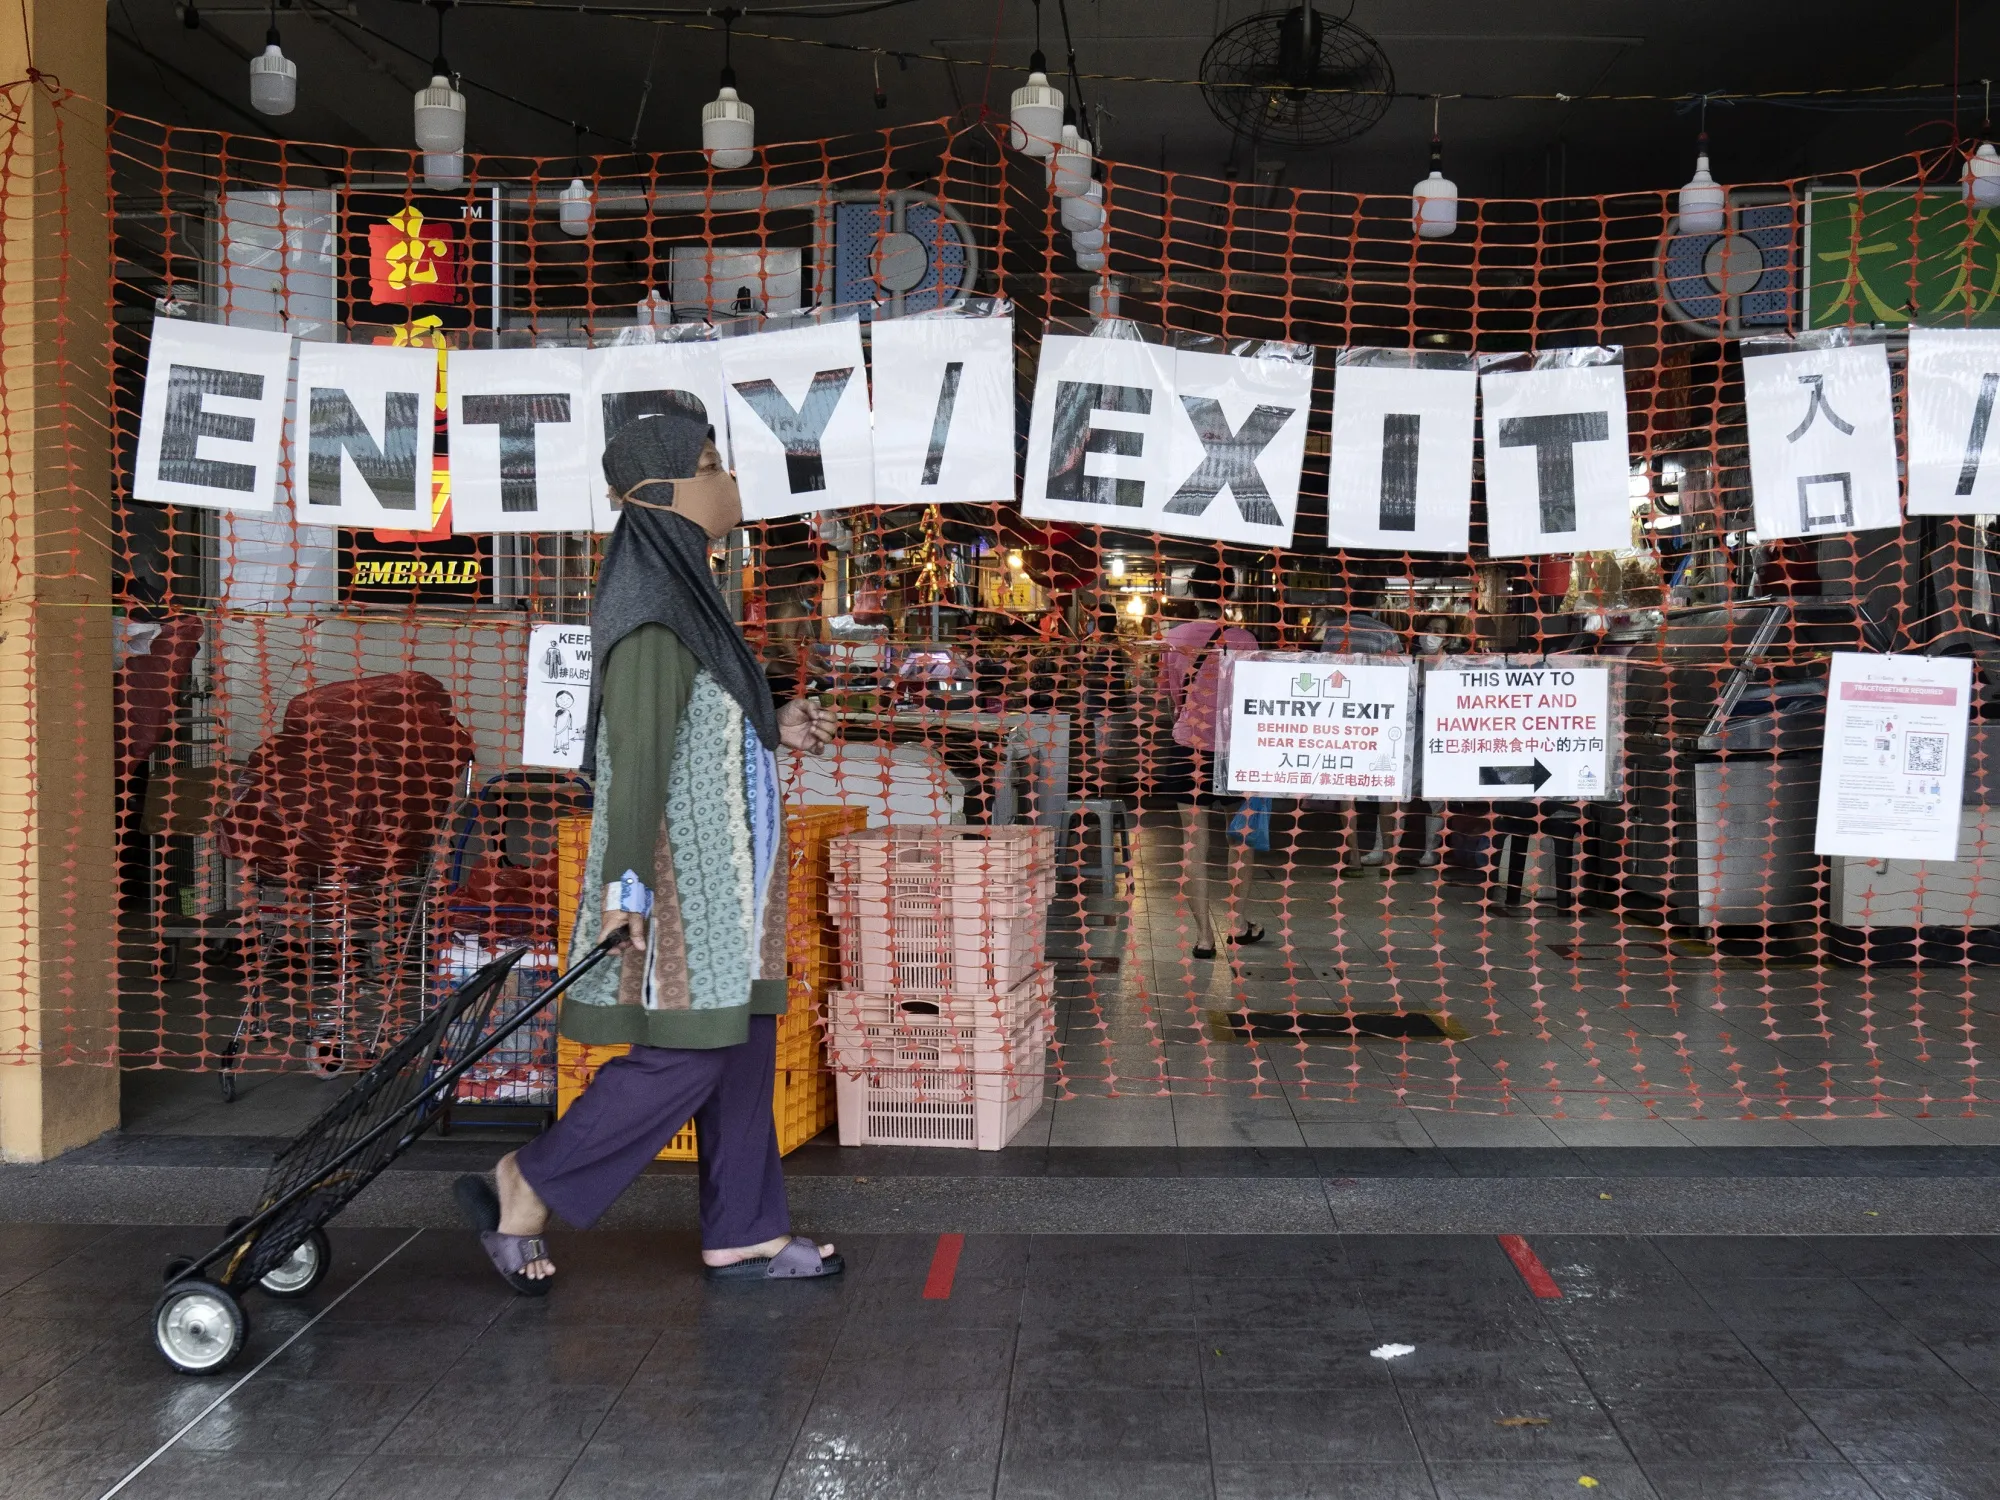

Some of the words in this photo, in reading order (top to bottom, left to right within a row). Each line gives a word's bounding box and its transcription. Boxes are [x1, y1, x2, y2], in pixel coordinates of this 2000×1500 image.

[921, 361, 963, 486] /
[1046, 380, 1609, 534] EXIT
[1786, 374, 1855, 532] 入口
[351, 560, 482, 586] EMERALD
[1460, 672, 1500, 687] THIS
[1505, 672, 1545, 686] WAY
[1550, 671, 1575, 686] TO
[1854, 684, 1910, 694] TRACETOGETHER
[1911, 687, 1944, 695] REQUIRED
[1244, 698, 1321, 717] ENTRY
[1342, 703, 1395, 719] EXIT
[1457, 694, 1533, 709] MARKET
[1538, 694, 1577, 708] AND
[1257, 722, 1308, 734] BEHIND
[1313, 724, 1340, 735] BUS
[1344, 726, 1379, 736] STOP
[1436, 717, 1516, 731] HAWKER
[1522, 716, 1596, 730] CENTRE
[1257, 738, 1294, 748] NEAR
[1300, 739, 1378, 750] ESCALATOR
[1429, 737, 1603, 754] 往巴刹和熟食中心的方向
[1278, 753, 1353, 769] 入口/出口
[1235, 770, 1396, 787] 在巴士站后面/靠近电动扶梯
